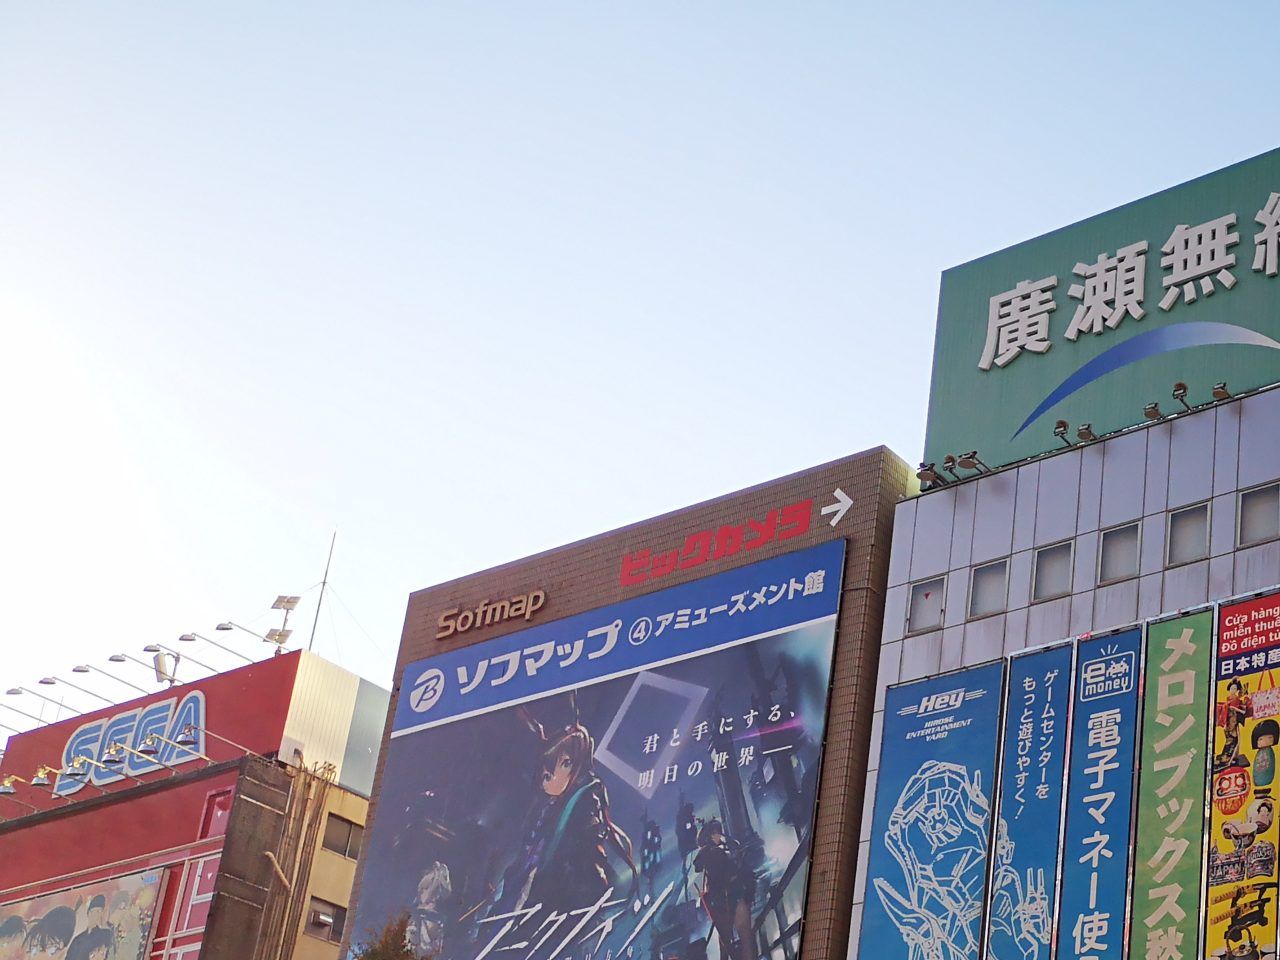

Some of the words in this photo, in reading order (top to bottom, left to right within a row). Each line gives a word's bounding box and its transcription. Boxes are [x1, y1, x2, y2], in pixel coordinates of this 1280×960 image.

[619, 500, 812, 587] ビックカメラ
[436, 590, 545, 640] Sofmap
[1251, 606, 1280, 621] hàng
[457, 619, 623, 695] ソフマップ
[1085, 673, 1130, 697] money
[917, 688, 965, 717] Hey
[642, 705, 796, 755] 君と手にする、
[906, 719, 973, 739] ENTERTAINMENT
[924, 716, 954, 728] HIROSE
[925, 732, 948, 741] YARD
[1035, 669, 1058, 800] ゲームセンターを
[52, 690, 206, 799] SEGA
[1211, 862, 1242, 879] JAPAN
